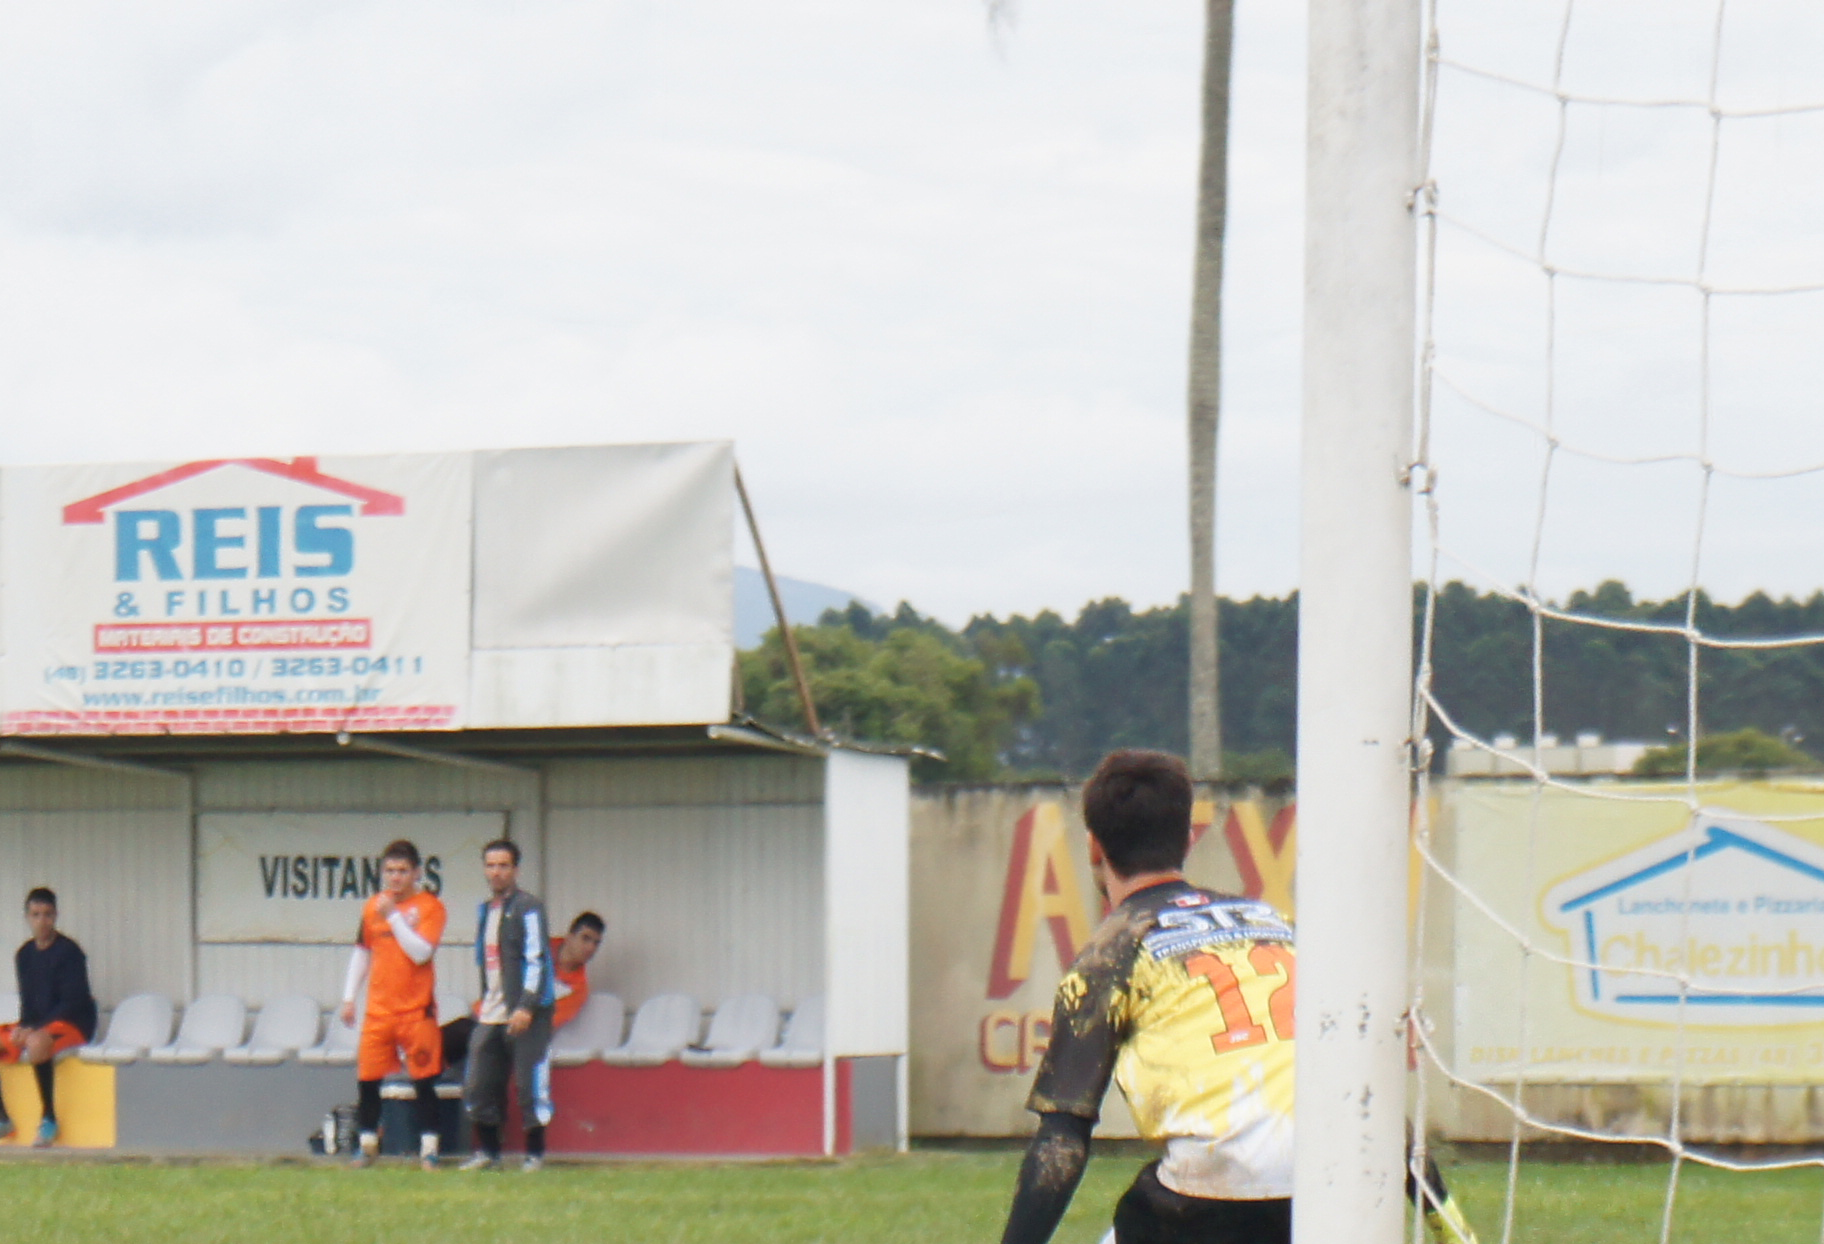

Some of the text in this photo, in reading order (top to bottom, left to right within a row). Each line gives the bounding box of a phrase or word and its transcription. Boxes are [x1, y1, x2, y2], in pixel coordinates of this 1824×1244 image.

[113, 504, 355, 582] REIS
[113, 587, 352, 617] & FILHOS
[206, 627, 234, 645] DE
[94, 658, 245, 680] 3263-0410
[271, 656, 423, 677] 3263-0411
[259, 856, 442, 899] VISITANS
[1601, 929, 1824, 978] Chalezinh
